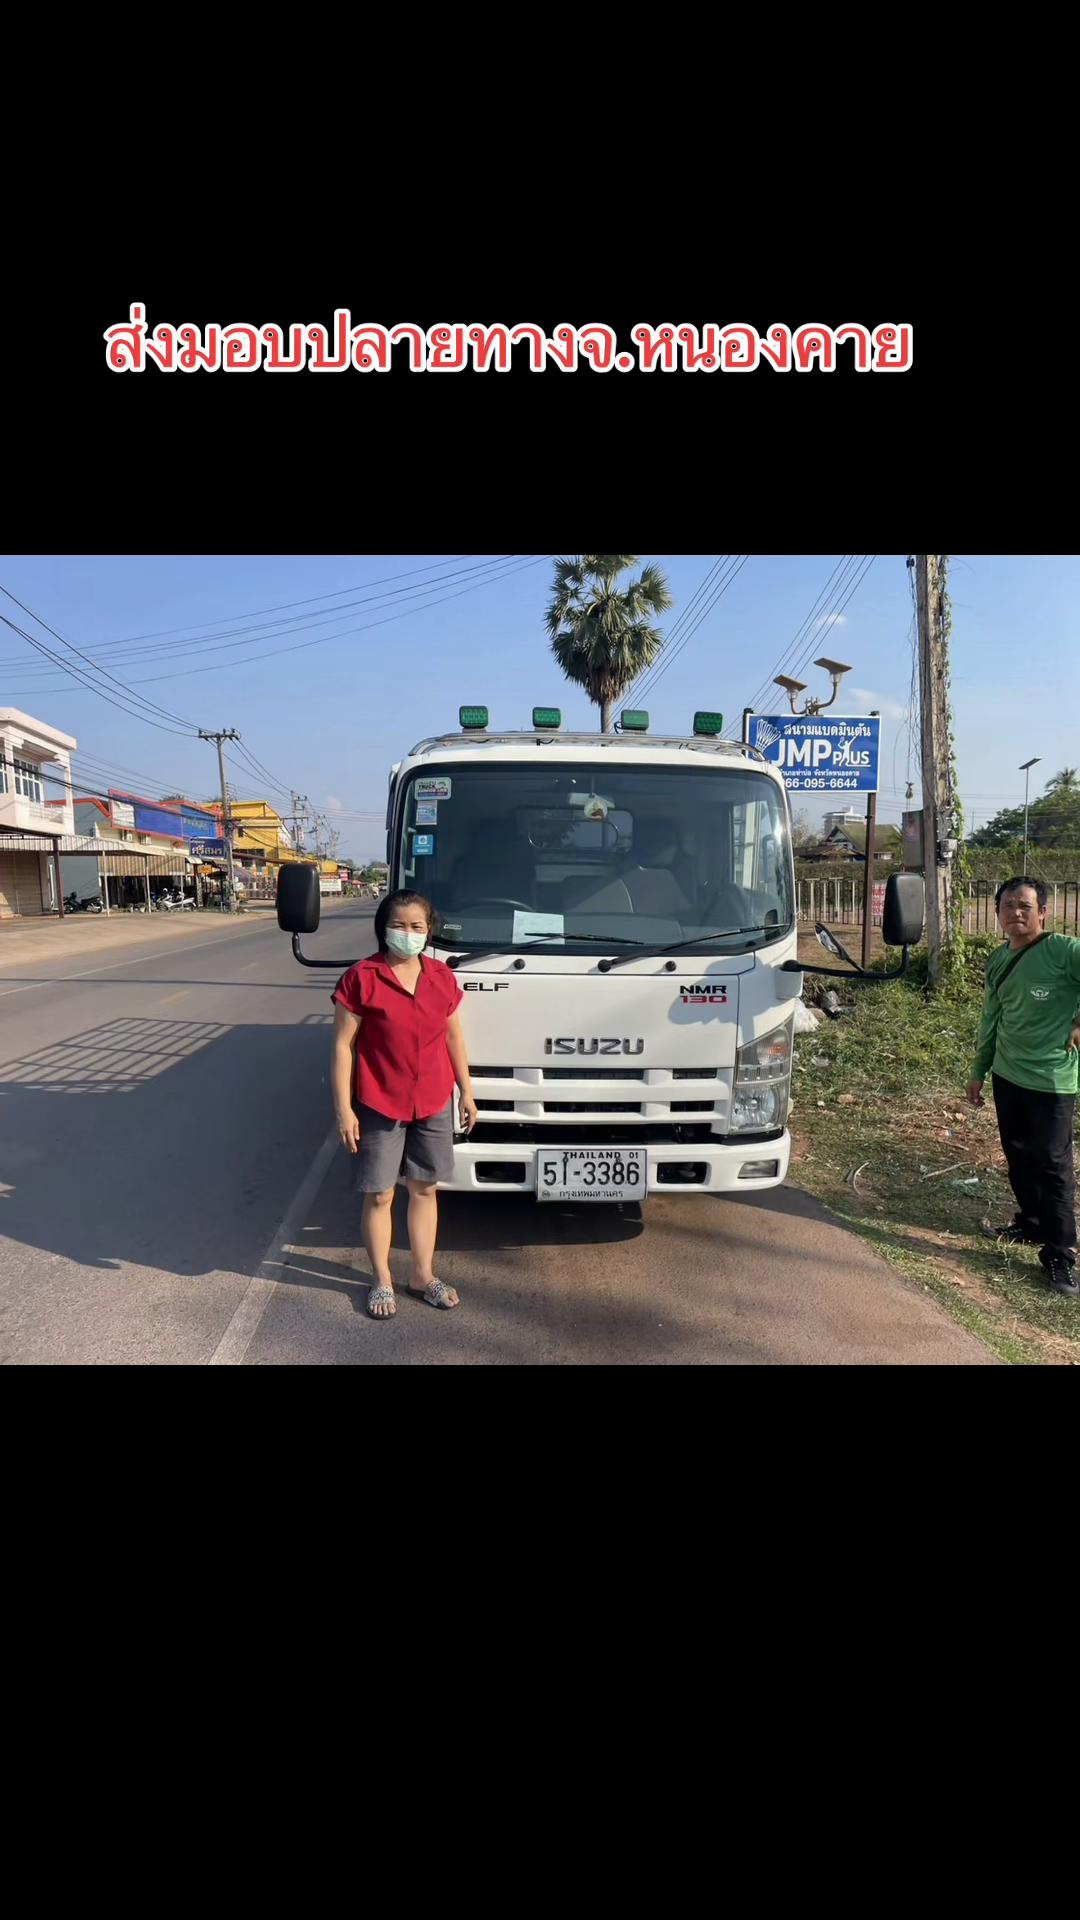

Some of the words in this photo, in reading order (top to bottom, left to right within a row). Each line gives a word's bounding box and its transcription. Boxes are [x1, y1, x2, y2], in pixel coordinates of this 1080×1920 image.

[784, 722, 871, 736] สนามแบดมินตัน
[771, 739, 832, 767] JMP
[784, 777, 858, 789] 66-095-6644
[463, 982, 510, 992] ELF
[680, 985, 727, 994] NMR
[680, 995, 727, 1004] 130
[544, 1038, 644, 1055] ISUZU
[544, 1161, 640, 1186] 51-3386
[560, 1190, 624, 1199] กรุงเทพมหานคร
